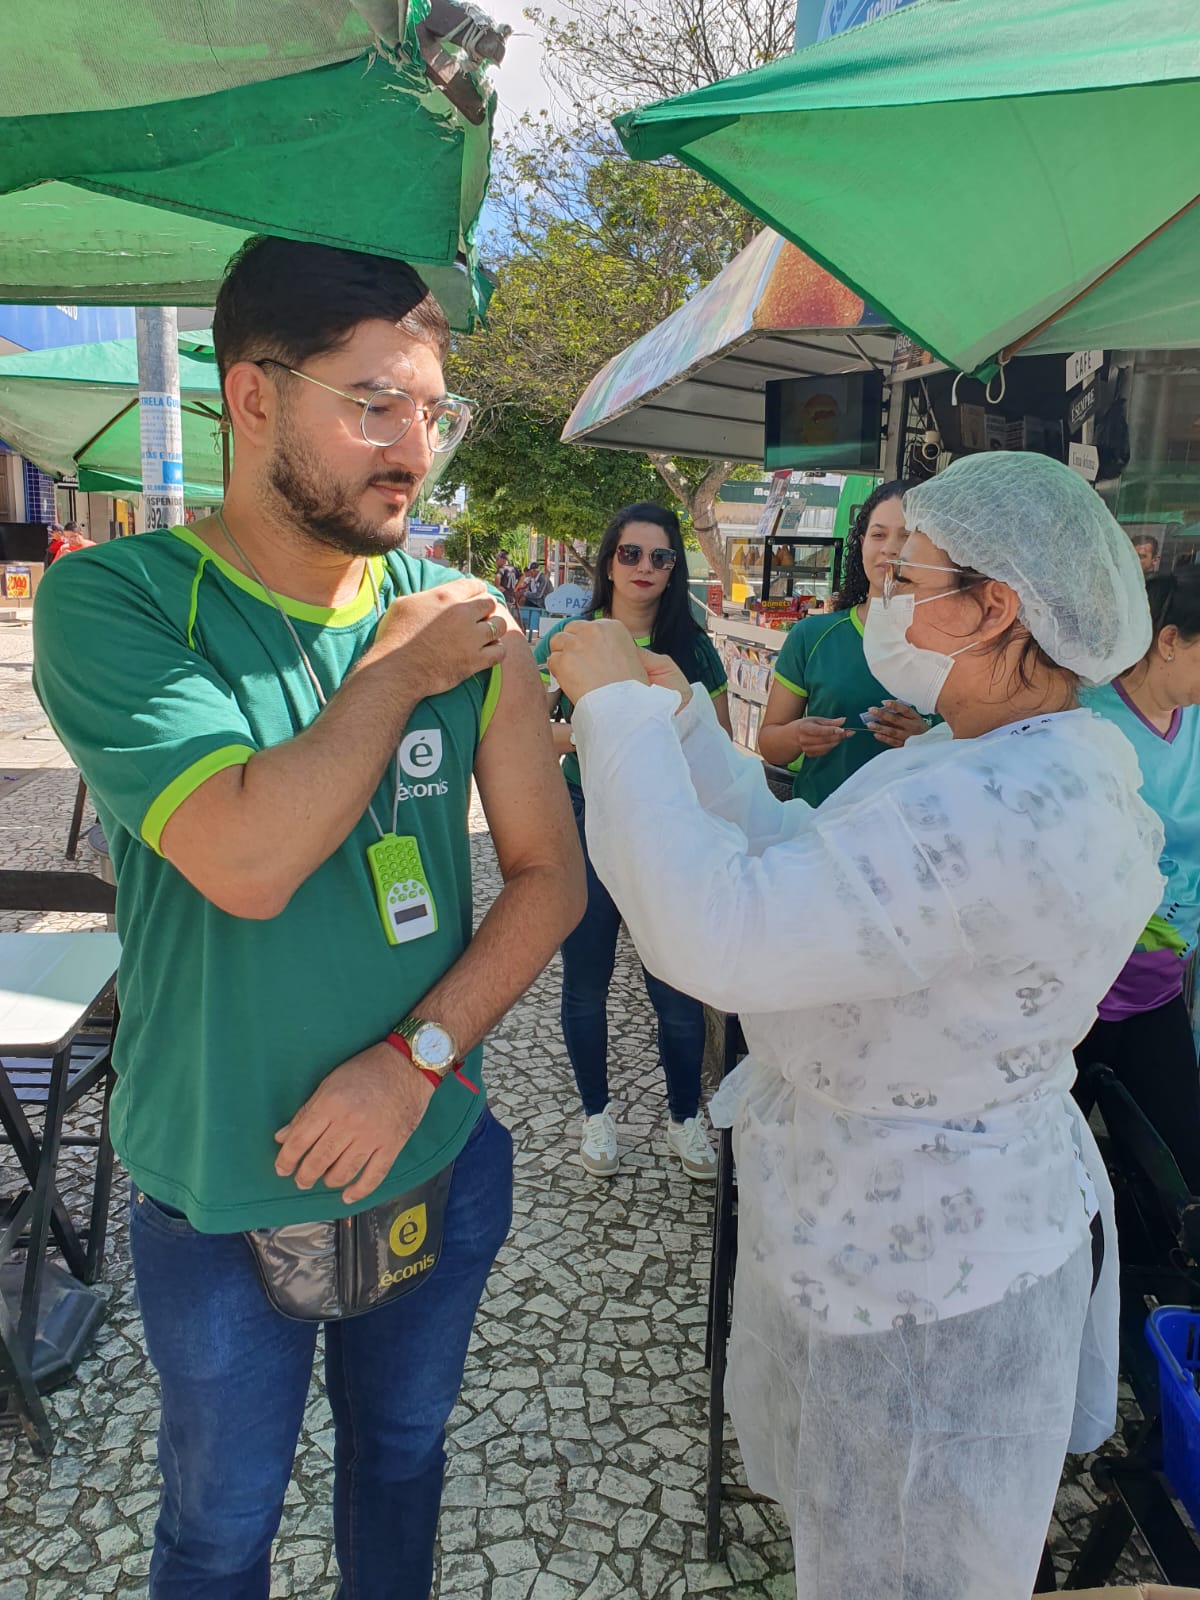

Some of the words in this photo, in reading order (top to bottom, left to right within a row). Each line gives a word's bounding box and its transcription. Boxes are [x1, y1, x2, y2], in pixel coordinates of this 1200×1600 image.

[565, 598, 588, 608] PAZ
[409, 736, 433, 767] é
[397, 778, 449, 801] éconis
[398, 1215, 418, 1245] é
[380, 1253, 435, 1287] éconis
